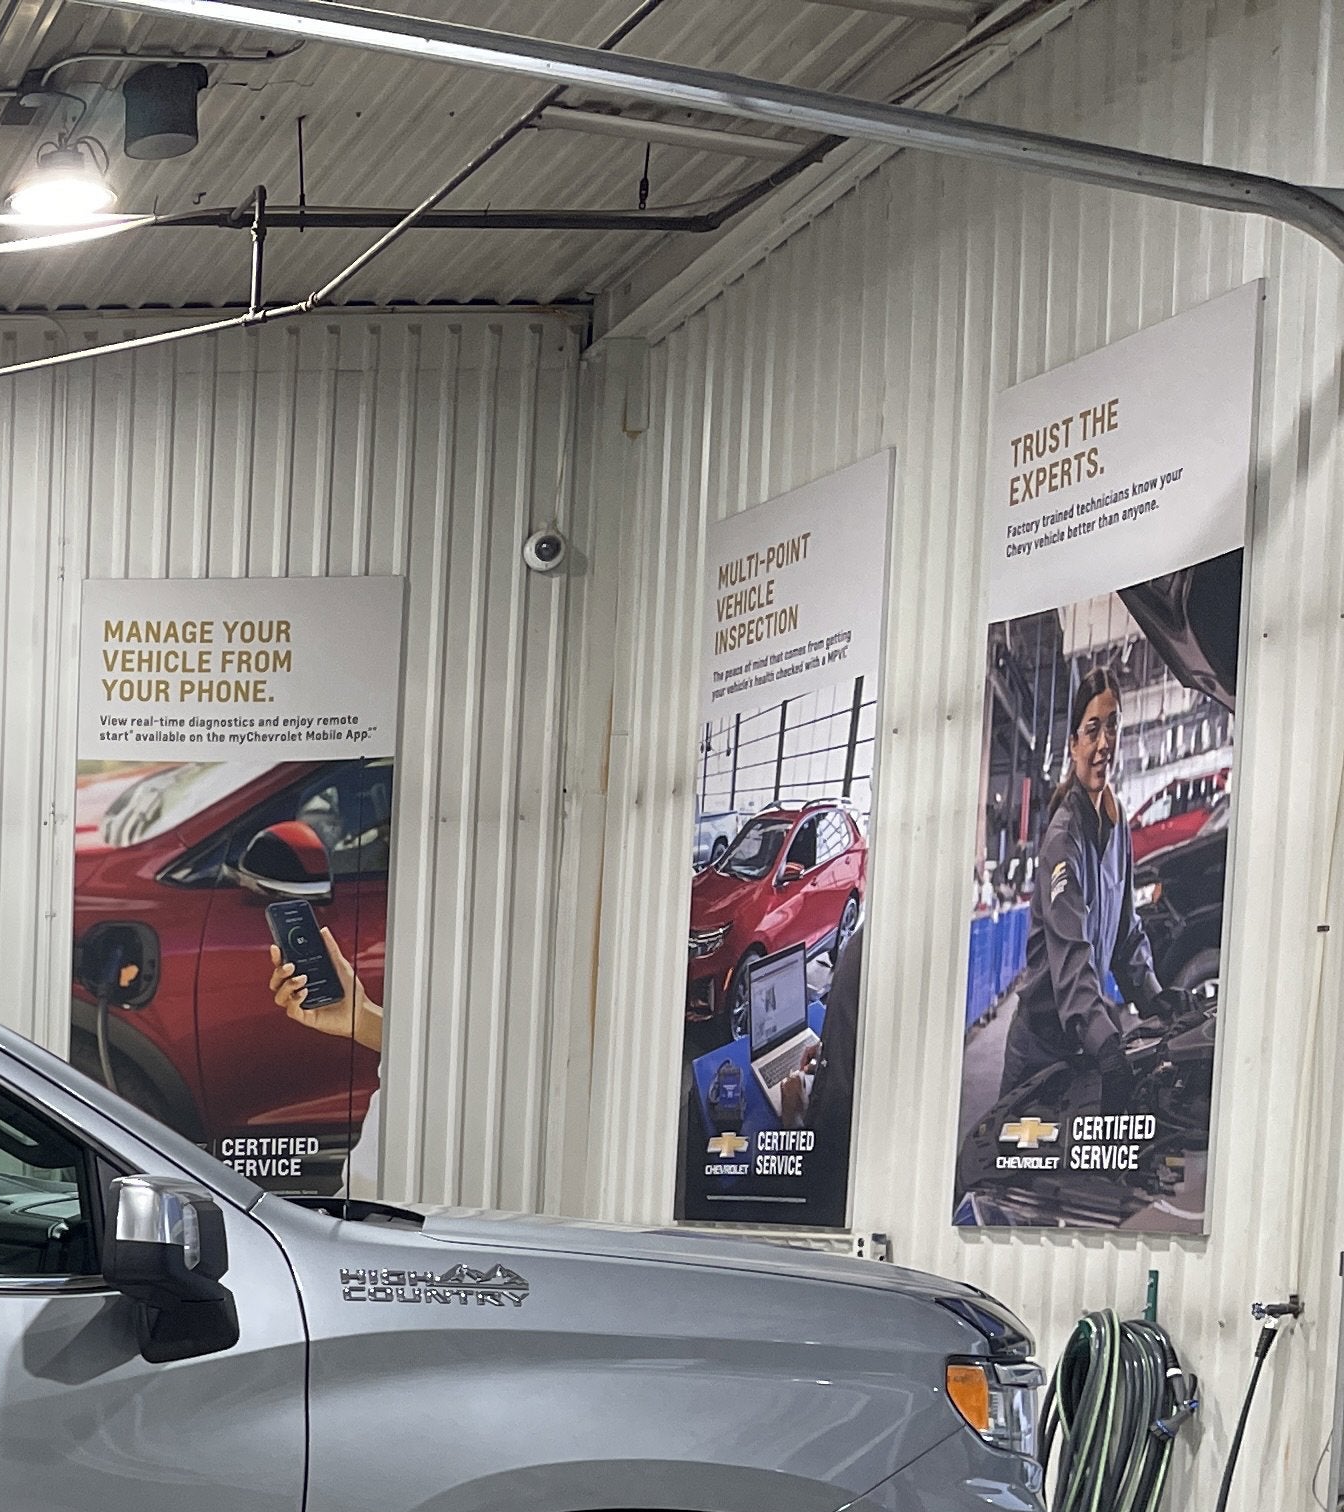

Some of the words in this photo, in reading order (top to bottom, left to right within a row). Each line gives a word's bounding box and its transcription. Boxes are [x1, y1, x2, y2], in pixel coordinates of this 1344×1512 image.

[1011, 416, 1073, 467] TRUST
[1080, 398, 1119, 441] THE
[1009, 447, 1105, 506] EXPERTS.
[1007, 517, 1040, 538] Factory
[1042, 504, 1075, 527] trained
[1076, 487, 1130, 515] technicians
[1132, 478, 1158, 497] know
[1159, 467, 1183, 490] your
[1006, 541, 1032, 558] Chevy
[1034, 529, 1065, 550] vehicle
[1067, 519, 1096, 539] better
[1099, 511, 1120, 529] than
[1122, 499, 1159, 521] anyone.
[718, 532, 811, 590] MULTI-POINT
[717, 580, 775, 622] VEHICLE
[104, 620, 214, 643] MANAGE
[222, 620, 291, 644] YOUR
[715, 604, 799, 655] INSPECTION
[102, 649, 211, 673] VEHICLE
[221, 650, 292, 673] FROM
[102, 679, 170, 702] YOUR
[179, 680, 274, 703] PHONE.
[99, 715, 128, 726] View
[131, 715, 185, 727] real-time
[189, 716, 255, 730] diagnostics
[258, 716, 279, 727] and
[282, 716, 314, 729] enjoy
[317, 715, 359, 726] remote
[135, 731, 186, 742] available
[189, 733, 203, 742] on
[207, 732, 225, 742] the
[229, 731, 302, 745] myChevrolet
[306, 730, 343, 741] Mobile
[1072, 1115, 1156, 1141] CERTIFIED
[221, 1137, 319, 1156] CERTIFIED
[757, 1131, 815, 1152] CERTIFIED
[705, 1164, 749, 1175] CHEVROLET
[755, 1155, 803, 1176] SERVICE
[996, 1156, 1060, 1169] CHEVROLET
[1070, 1145, 1139, 1170] SERVICE
[340, 1268, 435, 1287] HIGH
[342, 1287, 530, 1307] COUNTRY
